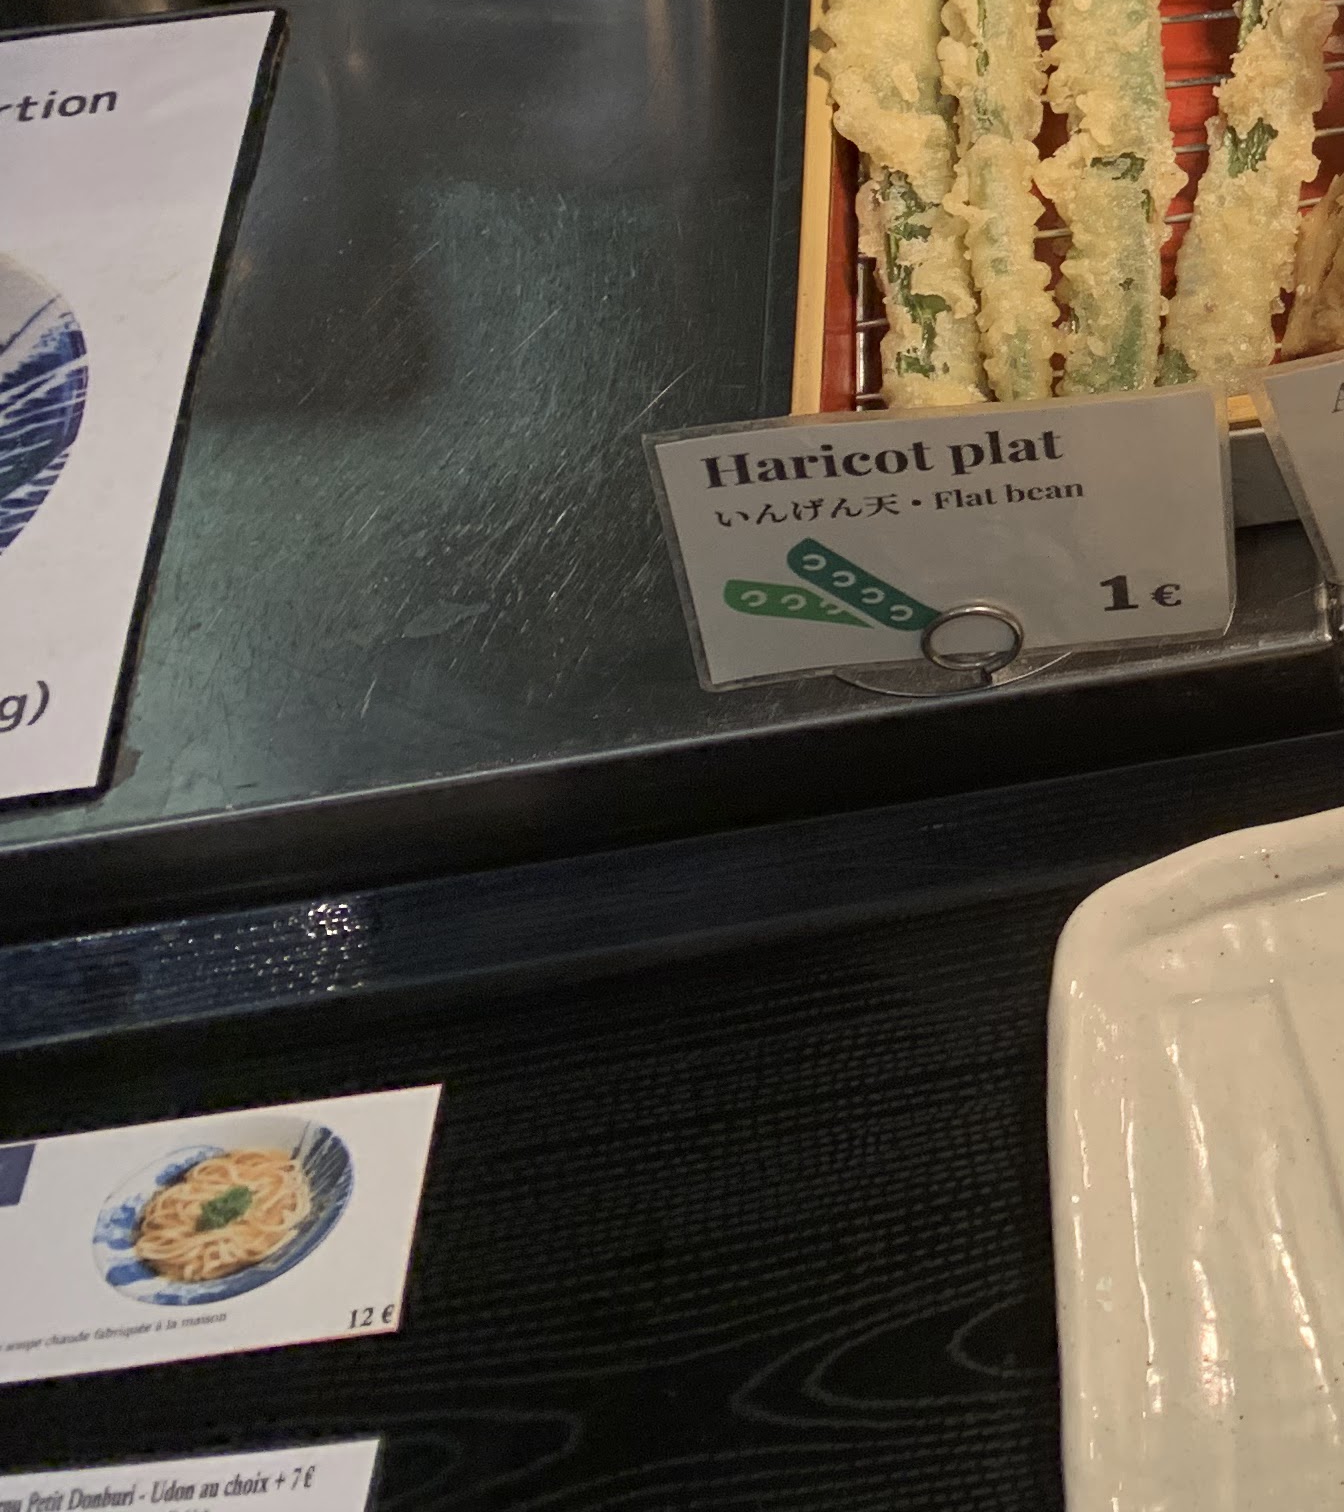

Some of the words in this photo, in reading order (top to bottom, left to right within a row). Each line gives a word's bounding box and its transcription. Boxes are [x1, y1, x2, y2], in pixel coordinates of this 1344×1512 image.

[700, 439, 935, 488] Haricot
[947, 428, 1065, 476] plat
[933, 486, 997, 512] Flat
[1005, 479, 1085, 504] bean
[149, 1478, 195, 1504] Udon
